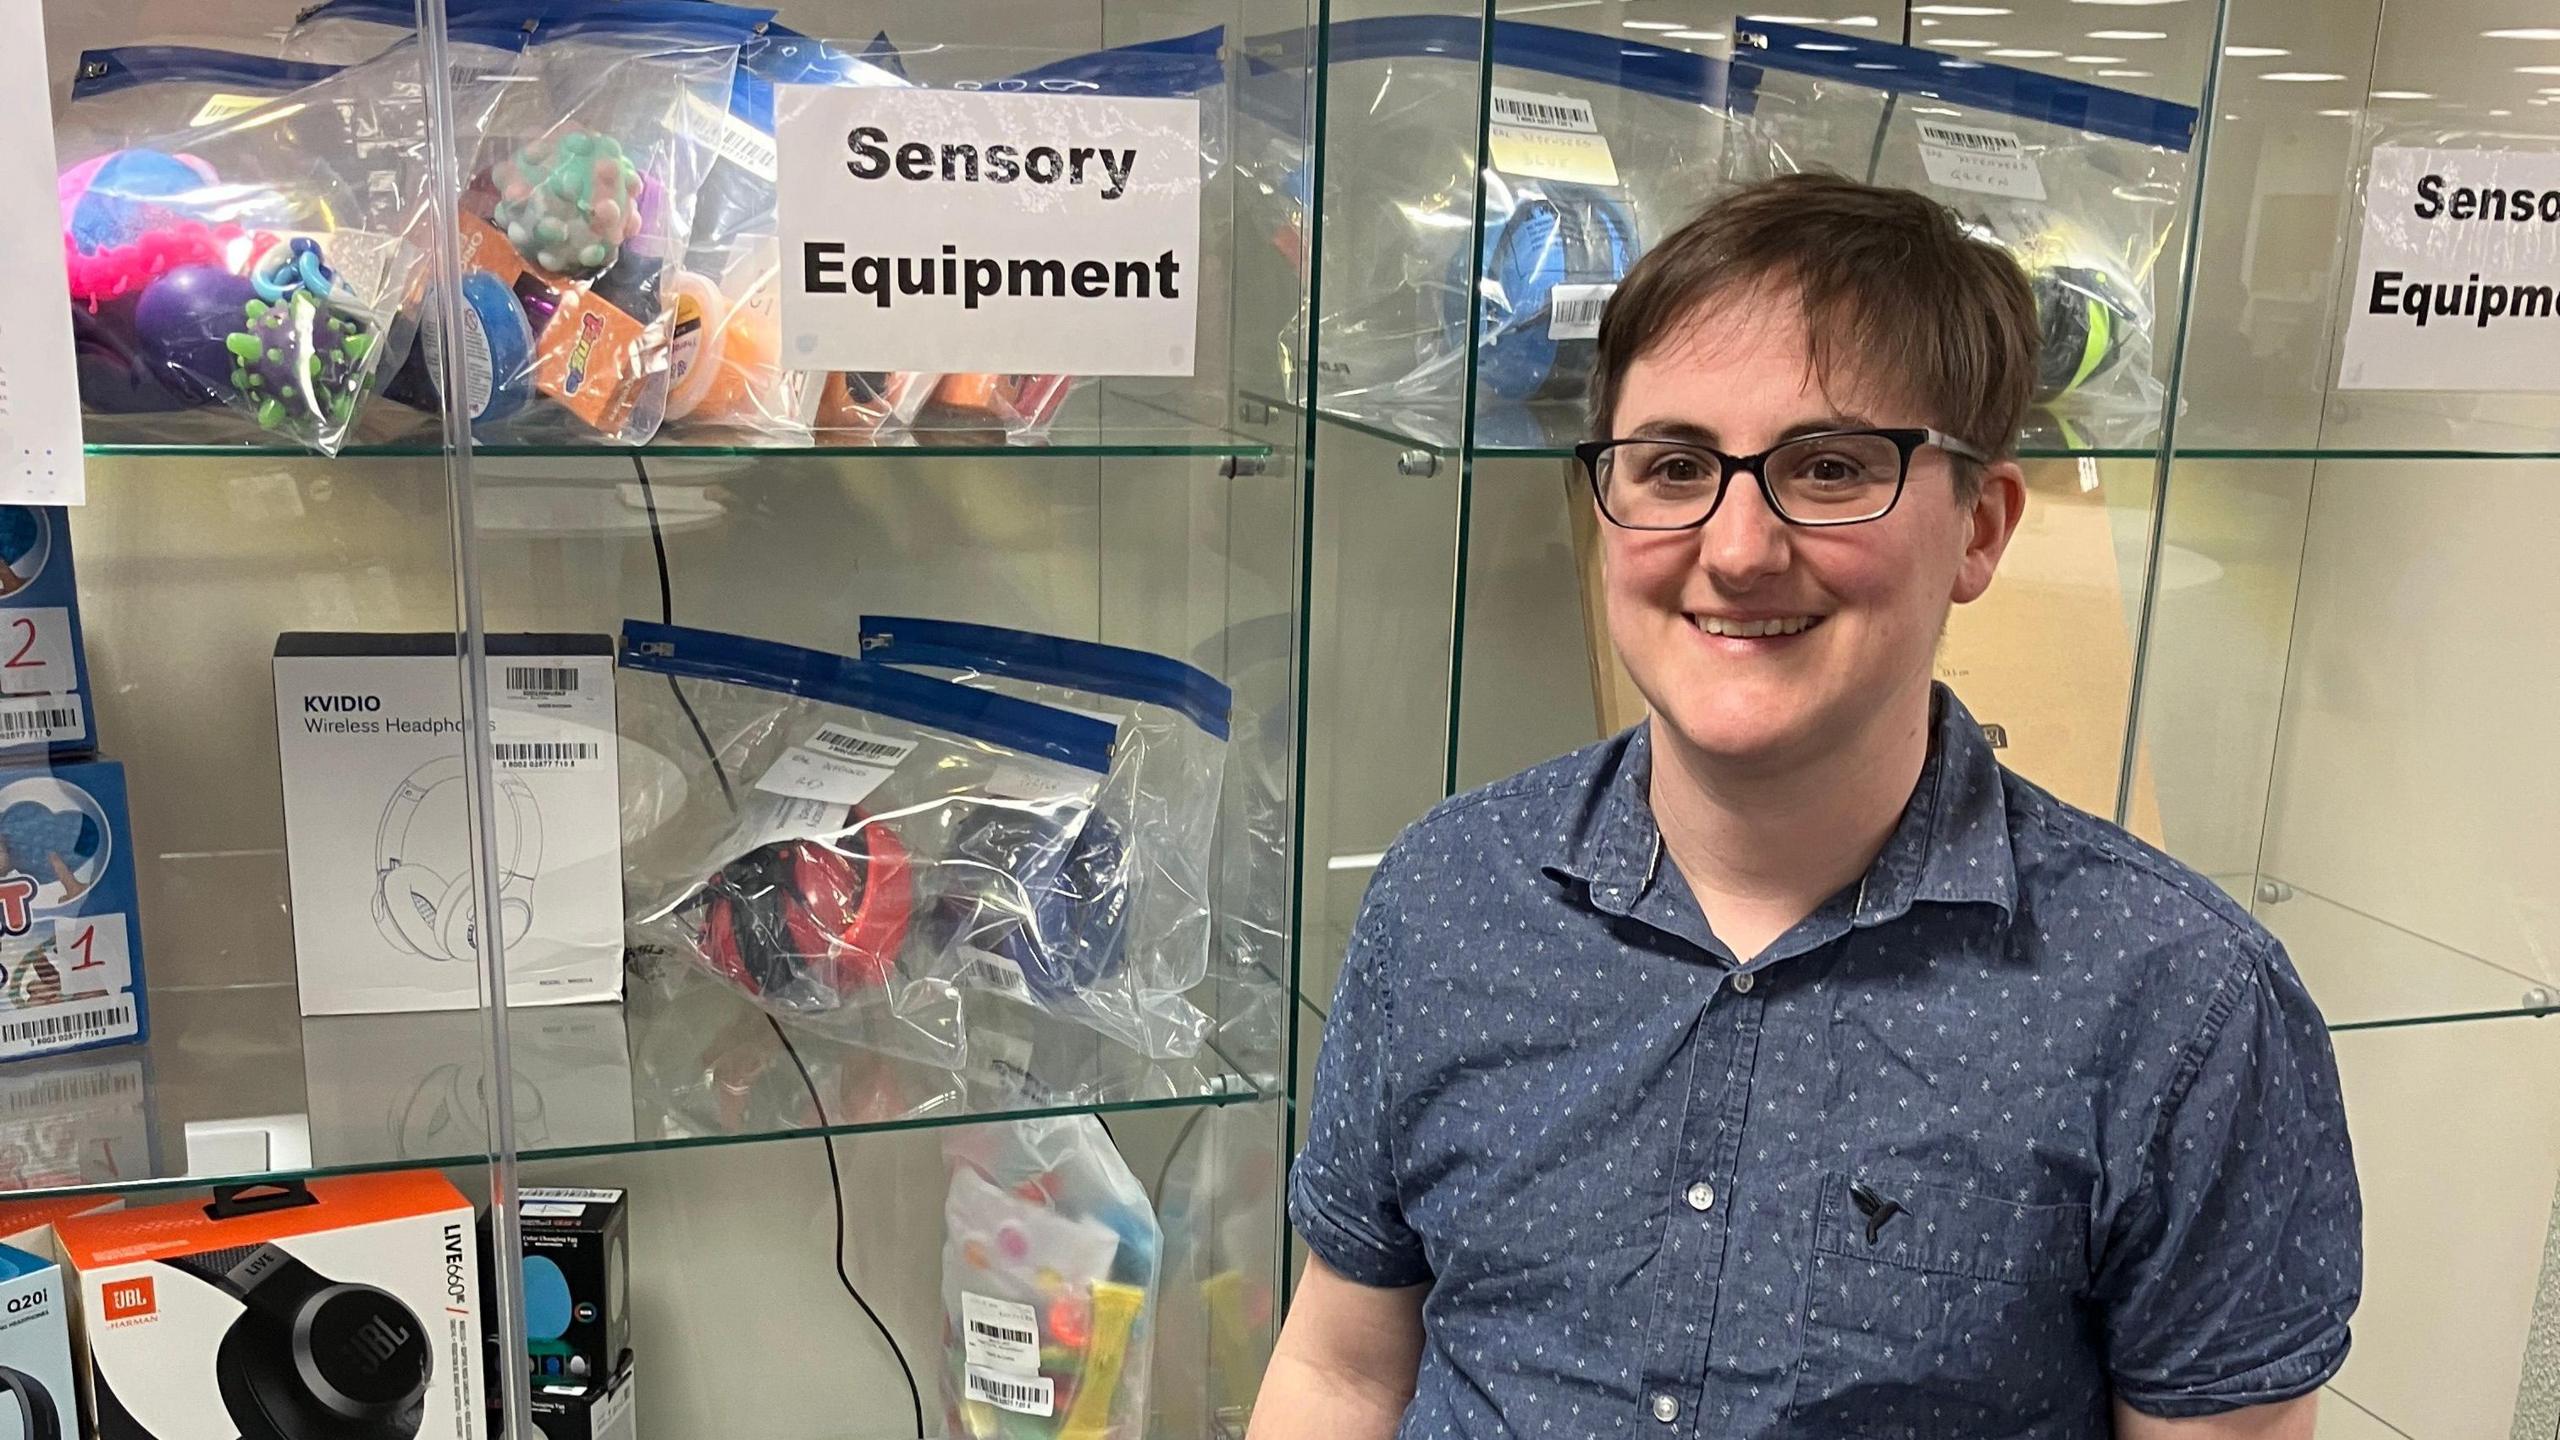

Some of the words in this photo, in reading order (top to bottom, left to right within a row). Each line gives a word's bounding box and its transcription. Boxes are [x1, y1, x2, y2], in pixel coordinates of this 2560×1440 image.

[847, 127, 1137, 200] Sensory
[2414, 174, 2560, 222] Senso
[803, 242, 1180, 309] Equipment
[2369, 271, 2560, 327] Equipm
[4, 618, 47, 668] 2
[304, 695, 381, 712] KVIDIO
[304, 717, 380, 733] Wireless
[70, 924, 106, 971] 1
[245, 1253, 275, 1276] LIVE
[7, 1288, 48, 1313] Q20i
[110, 1315, 159, 1329] HARMAN
[113, 1288, 147, 1310] JBL
[349, 1314, 411, 1374] JBL
